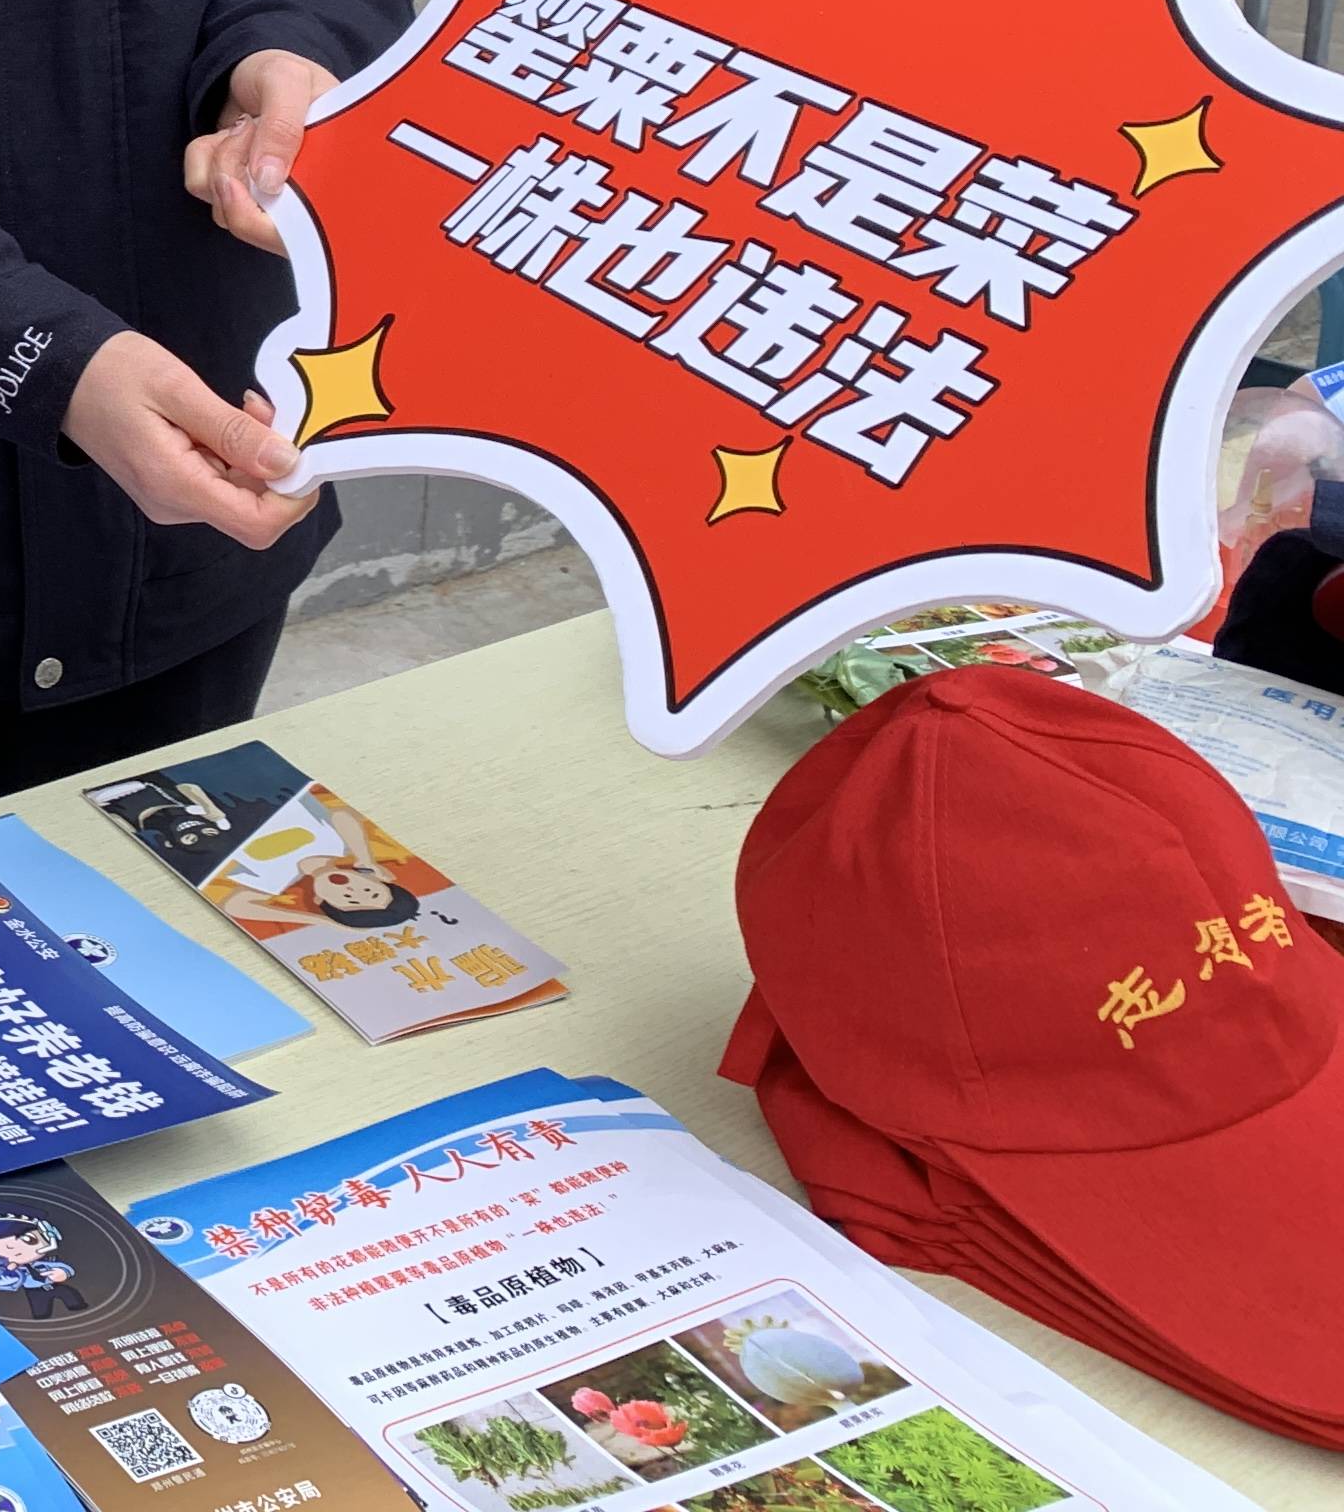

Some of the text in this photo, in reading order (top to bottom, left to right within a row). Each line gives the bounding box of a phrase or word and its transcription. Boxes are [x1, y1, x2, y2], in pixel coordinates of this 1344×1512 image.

[390, 123, 995, 485] 一株也违法
[1262, 687, 1344, 728] 医用
[3, 918, 62, 961] 金水公安
[392, 944, 528, 993] 骗术
[1098, 893, 1294, 1049] 志愿者
[207, 1120, 579, 1259] 禁种铲毒 人人有责
[422, 1247, 606, 1325] 【毒品原植物】
